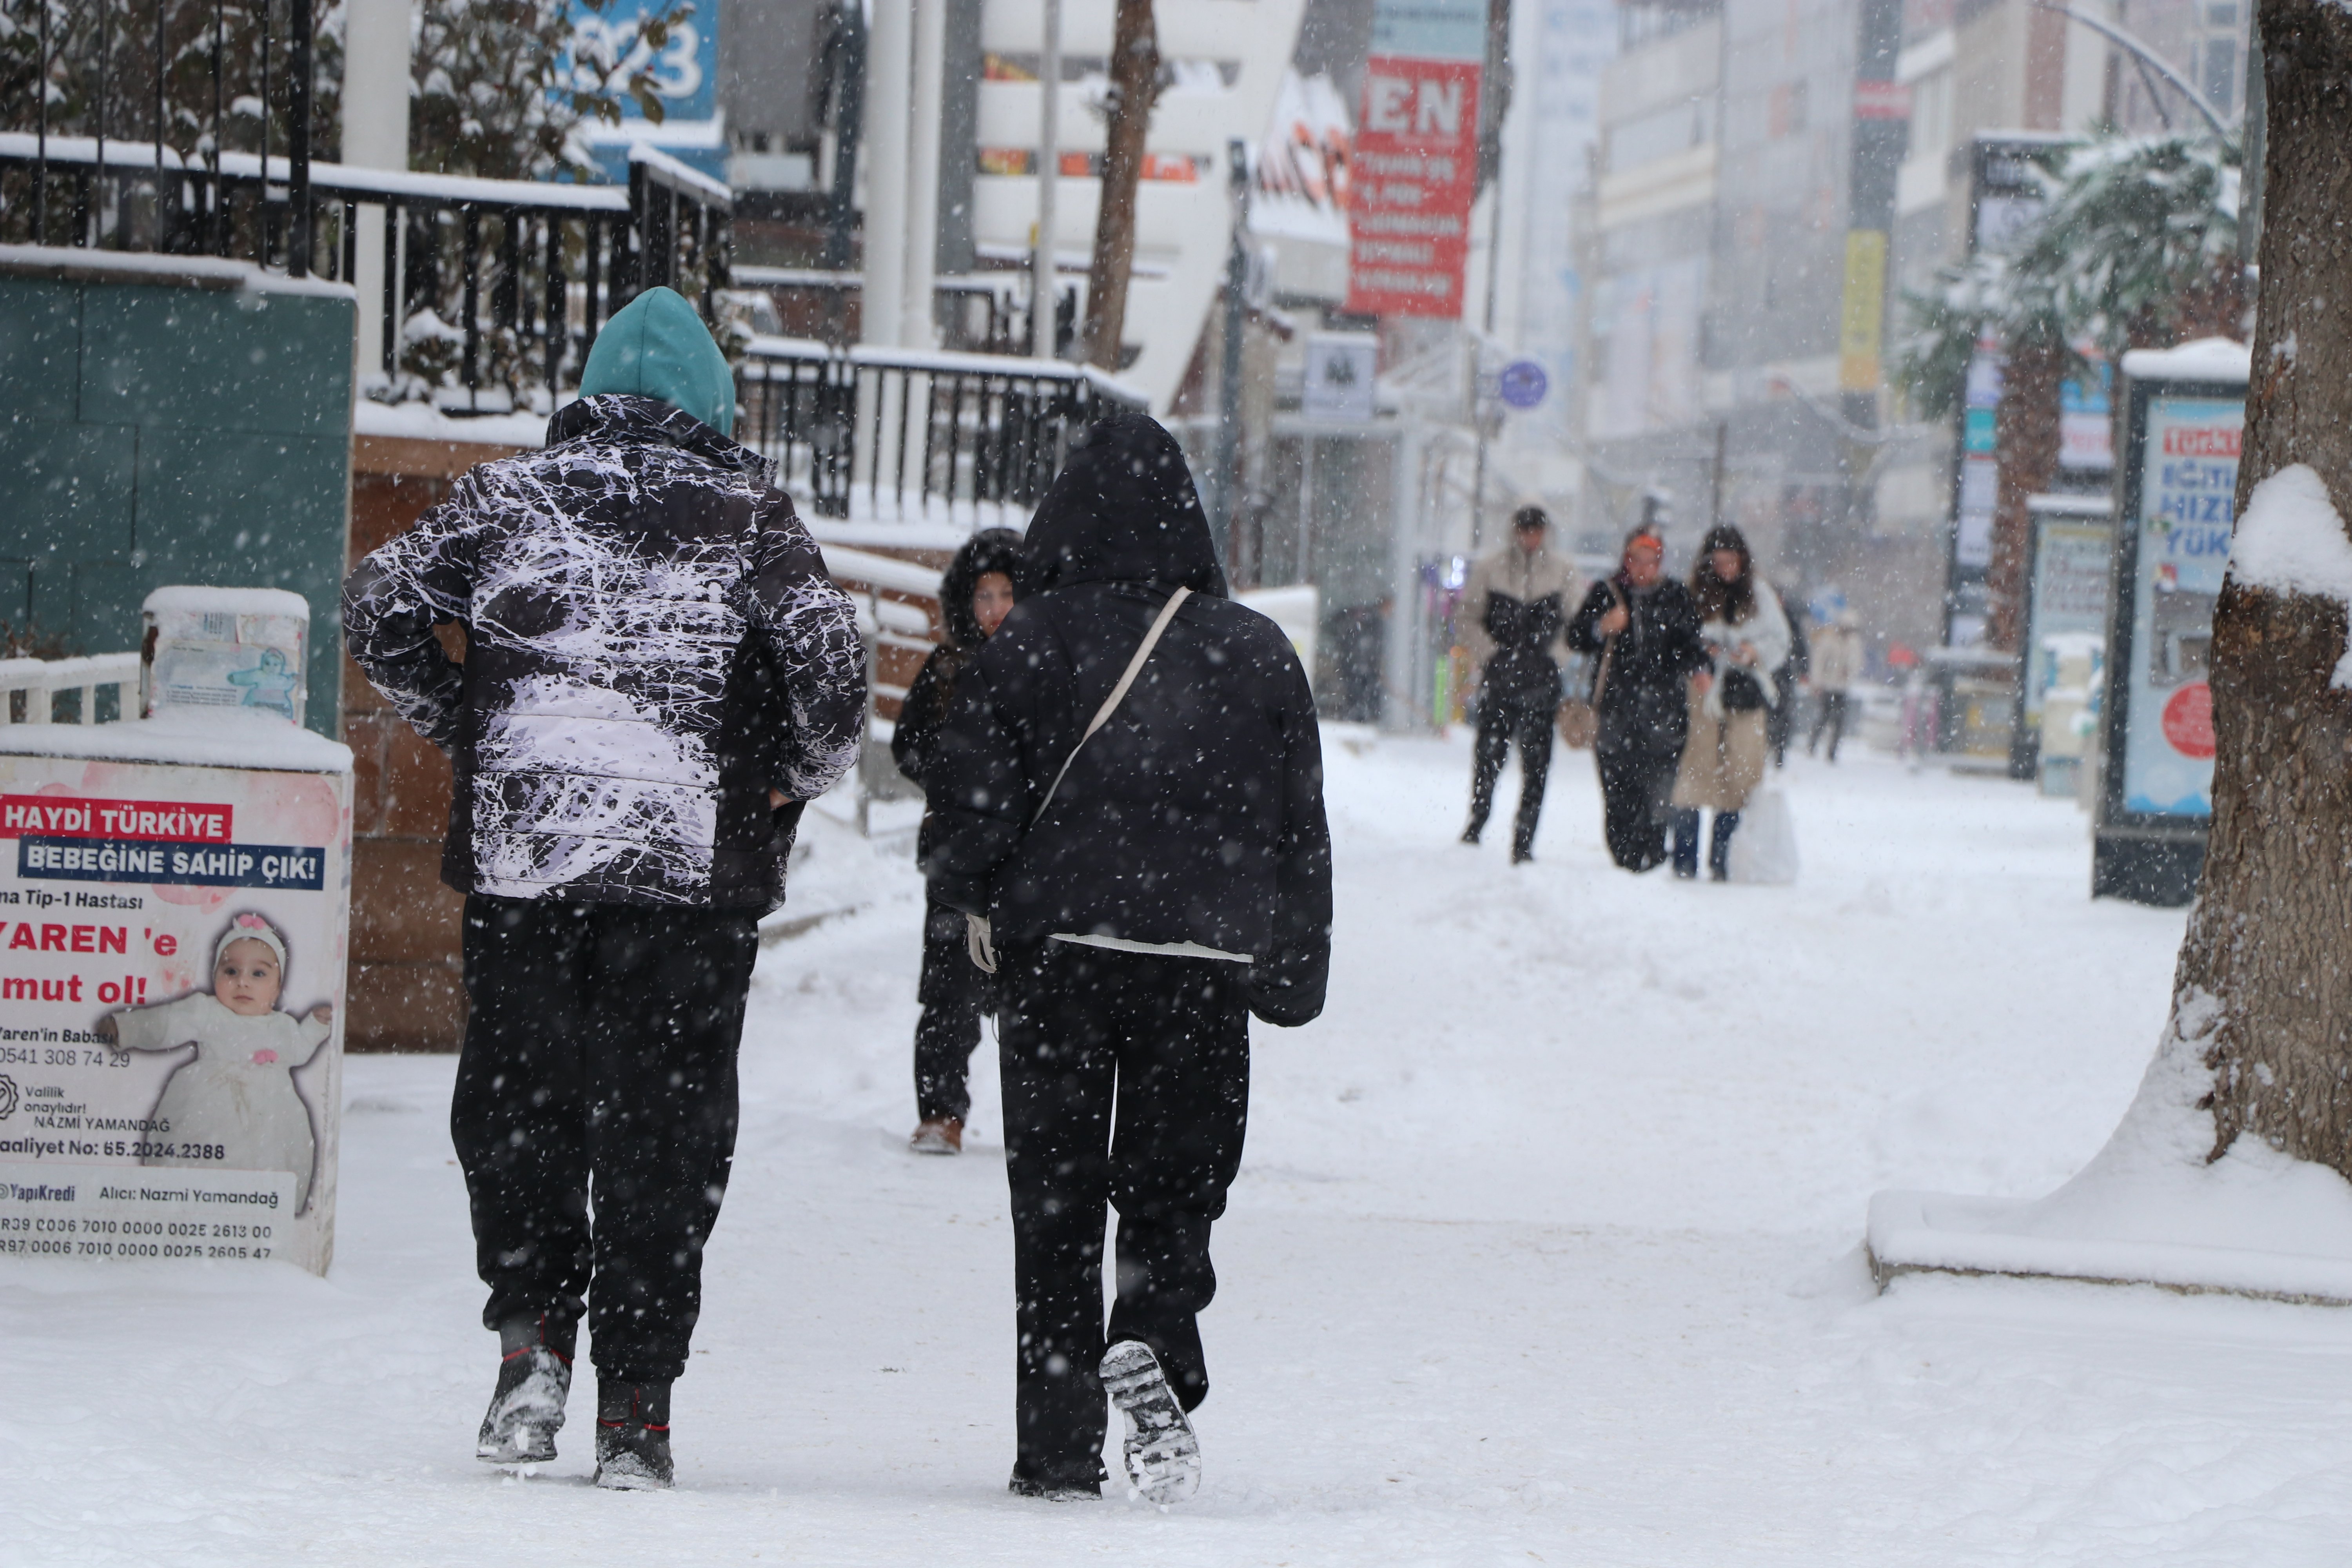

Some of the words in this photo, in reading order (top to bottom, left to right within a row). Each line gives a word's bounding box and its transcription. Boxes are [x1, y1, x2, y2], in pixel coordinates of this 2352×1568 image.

[1367, 76, 1463, 132] EN
[5, 803, 91, 832] HAYDİ
[101, 806, 223, 837] TÜRKİYE
[28, 842, 164, 873] BEBEĞİNE
[172, 848, 254, 877] SAHİP
[261, 855, 316, 884] ÇIK!
[25, 889, 70, 909] Tip-1
[76, 892, 143, 909] Hastası
[0, 922, 127, 954] AREN
[3, 975, 83, 1002] mut
[97, 975, 147, 1005] ol!
[0, 1027, 58, 1042] aren'in
[63, 1029, 114, 1044] Babası
[0, 1047, 38, 1064] 0541
[45, 1049, 76, 1065] 308
[83, 1051, 103, 1066] 74
[110, 1052, 130, 1067] 29
[25, 1086, 64, 1098] Valilik
[24, 1103, 86, 1116] onaylıdır!
[35, 1115, 81, 1129] NAZMİ
[86, 1118, 170, 1132] YAMANDAĞ
[0, 1138, 64, 1158] aaliyet
[69, 1140, 98, 1155] No:
[104, 1141, 224, 1160] 65.2024.2388
[10, 1184, 75, 1203] YapıKredi
[100, 1187, 136, 1200] Alıcı:
[140, 1188, 189, 1202] Nazmi
[192, 1190, 279, 1209] Yamandağ
[0, 1218, 30, 1230] R39
[37, 1219, 76, 1232] 0006
[82, 1220, 116, 1233] 7010
[122, 1222, 162, 1235] 0000
[169, 1223, 207, 1236] 0025
[253, 1226, 271, 1238] 00
[32, 1241, 72, 1254] 0006
[78, 1242, 112, 1255] 7010
[118, 1243, 158, 1256] 0000
[163, 1244, 202, 1257] 0025
[208, 1246, 247, 1258] 2605
[253, 1248, 271, 1259] 47
